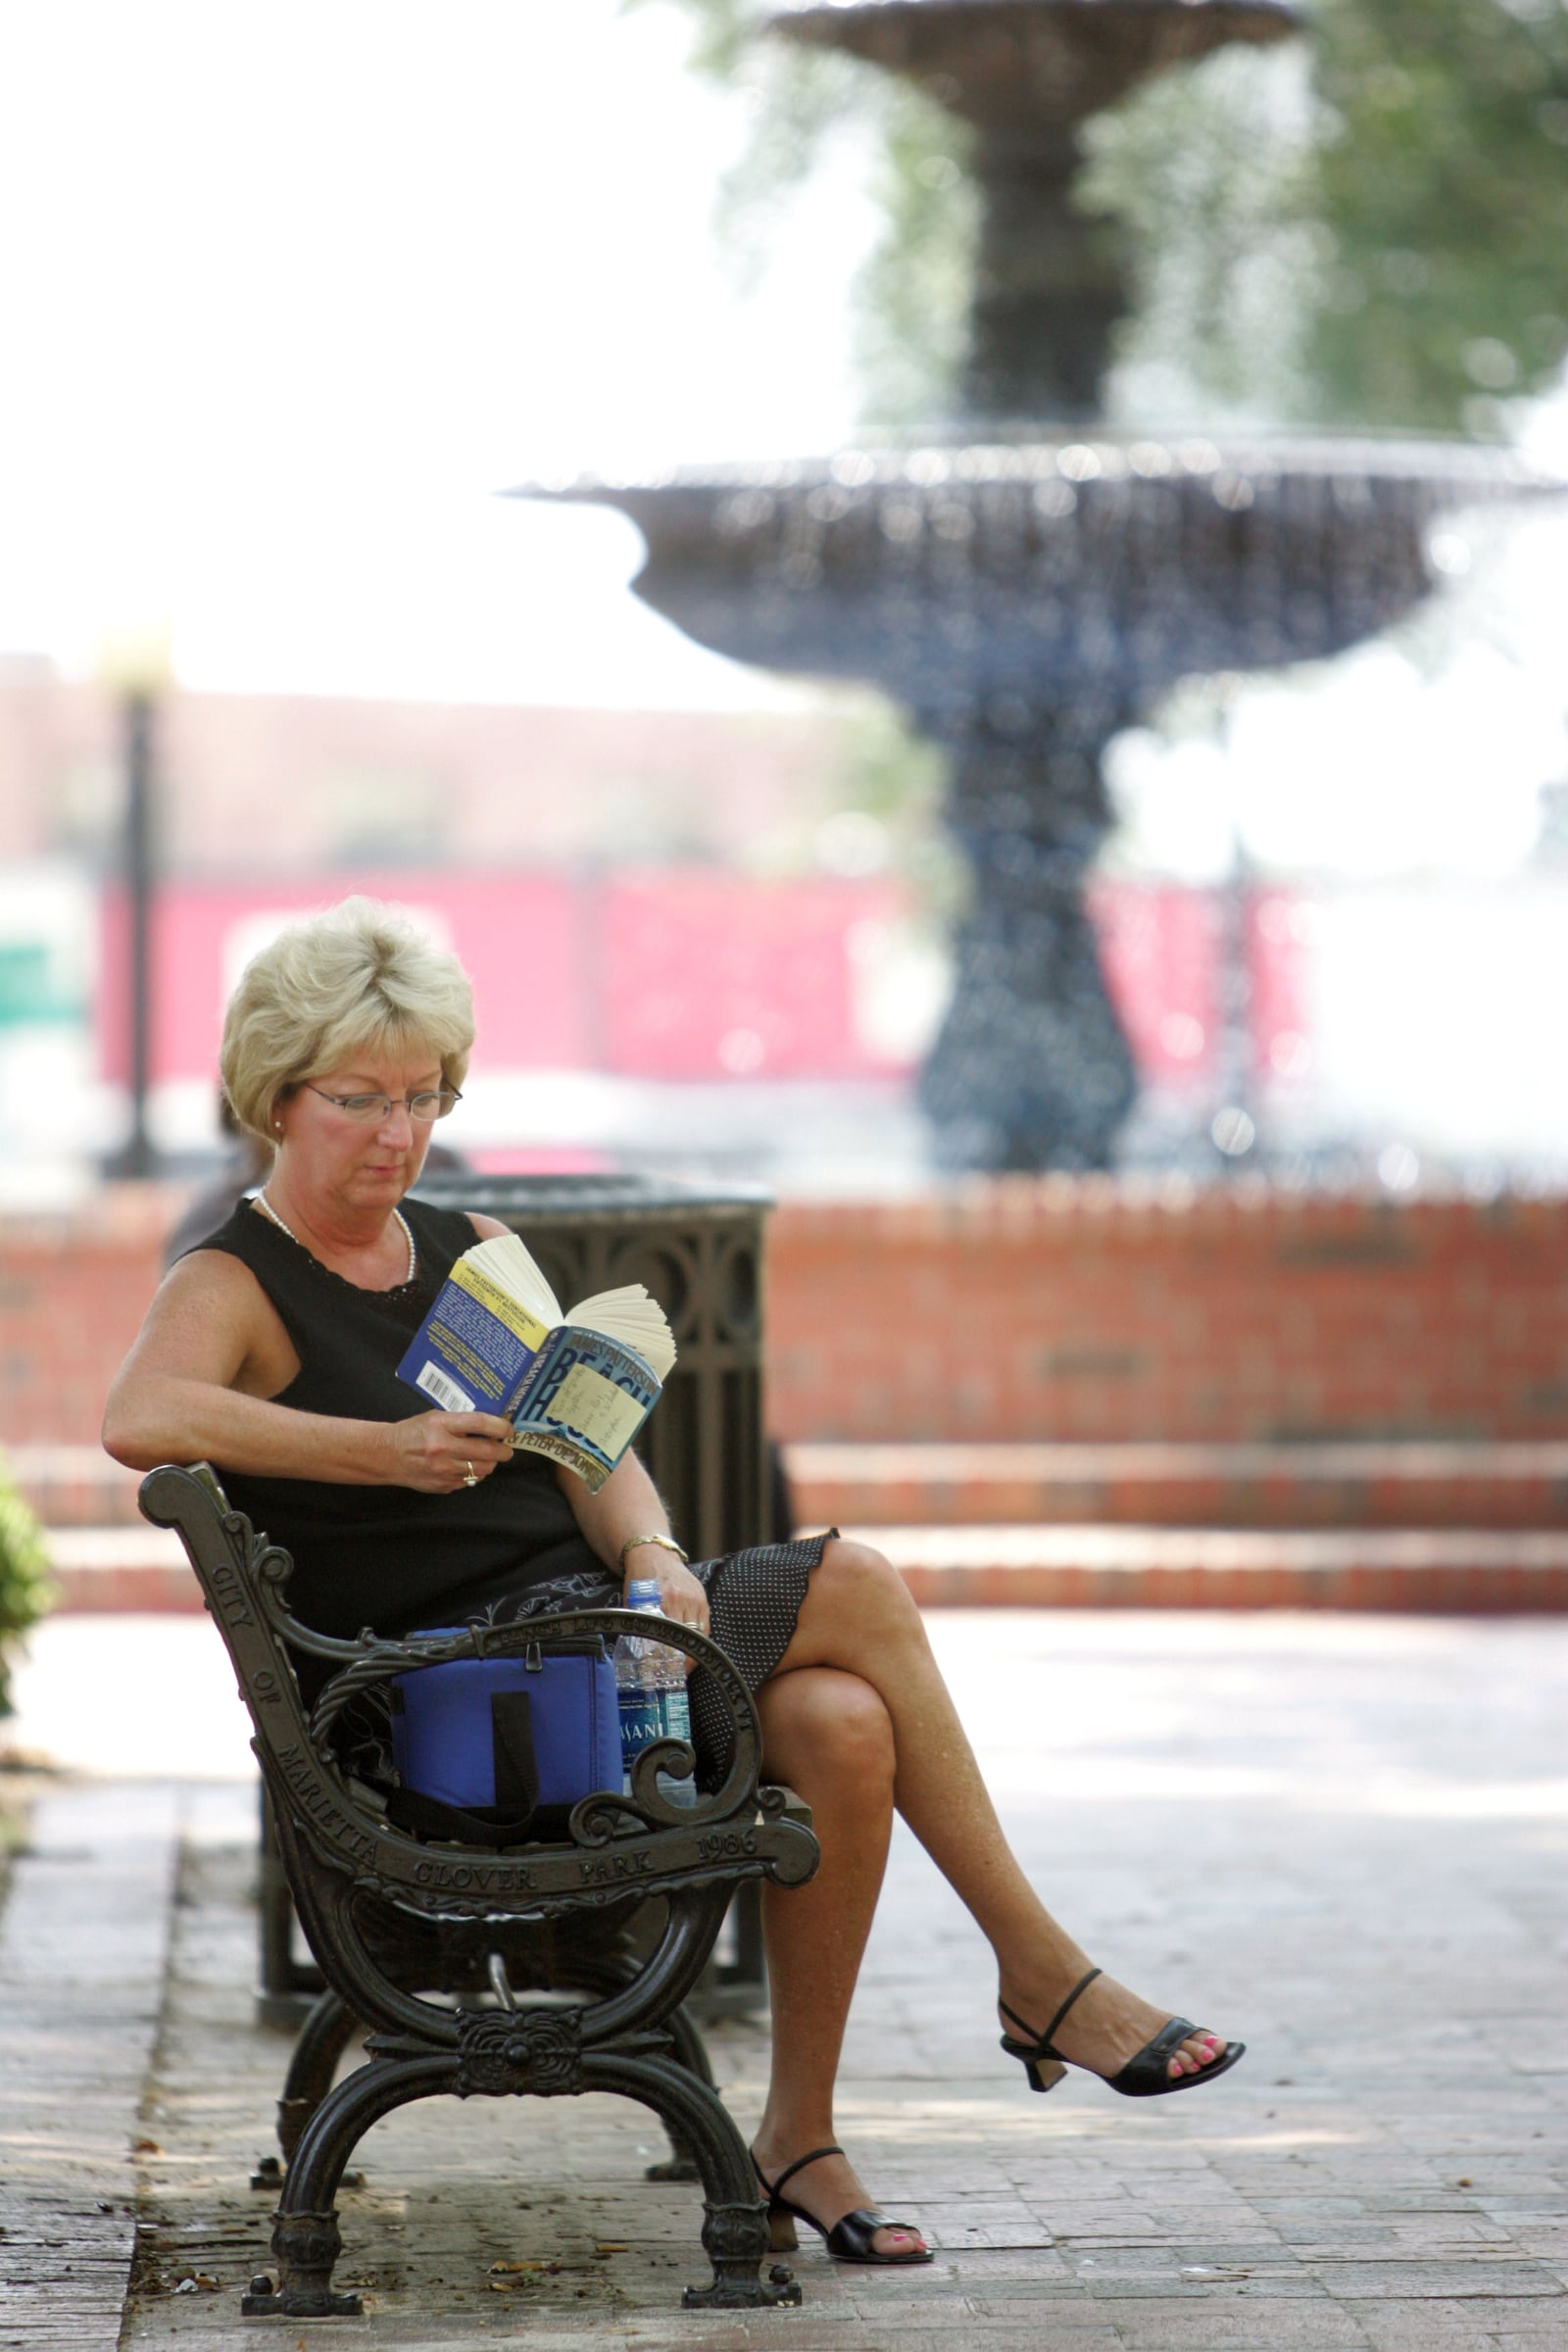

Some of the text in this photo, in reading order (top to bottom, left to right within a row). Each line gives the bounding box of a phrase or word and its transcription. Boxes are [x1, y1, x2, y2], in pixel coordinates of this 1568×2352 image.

[565, 1334, 604, 1355] JAMES
[602, 1346, 657, 1396] PATTERSON
[508, 1432, 519, 1445] &
[520, 1432, 555, 1452] PETER
[554, 1443, 570, 1460] DE
[212, 1566, 254, 1629] CITY
[252, 1670, 281, 1704] OF
[278, 1742, 379, 1863] MARIETTA
[578, 1849, 657, 1885] PARK
